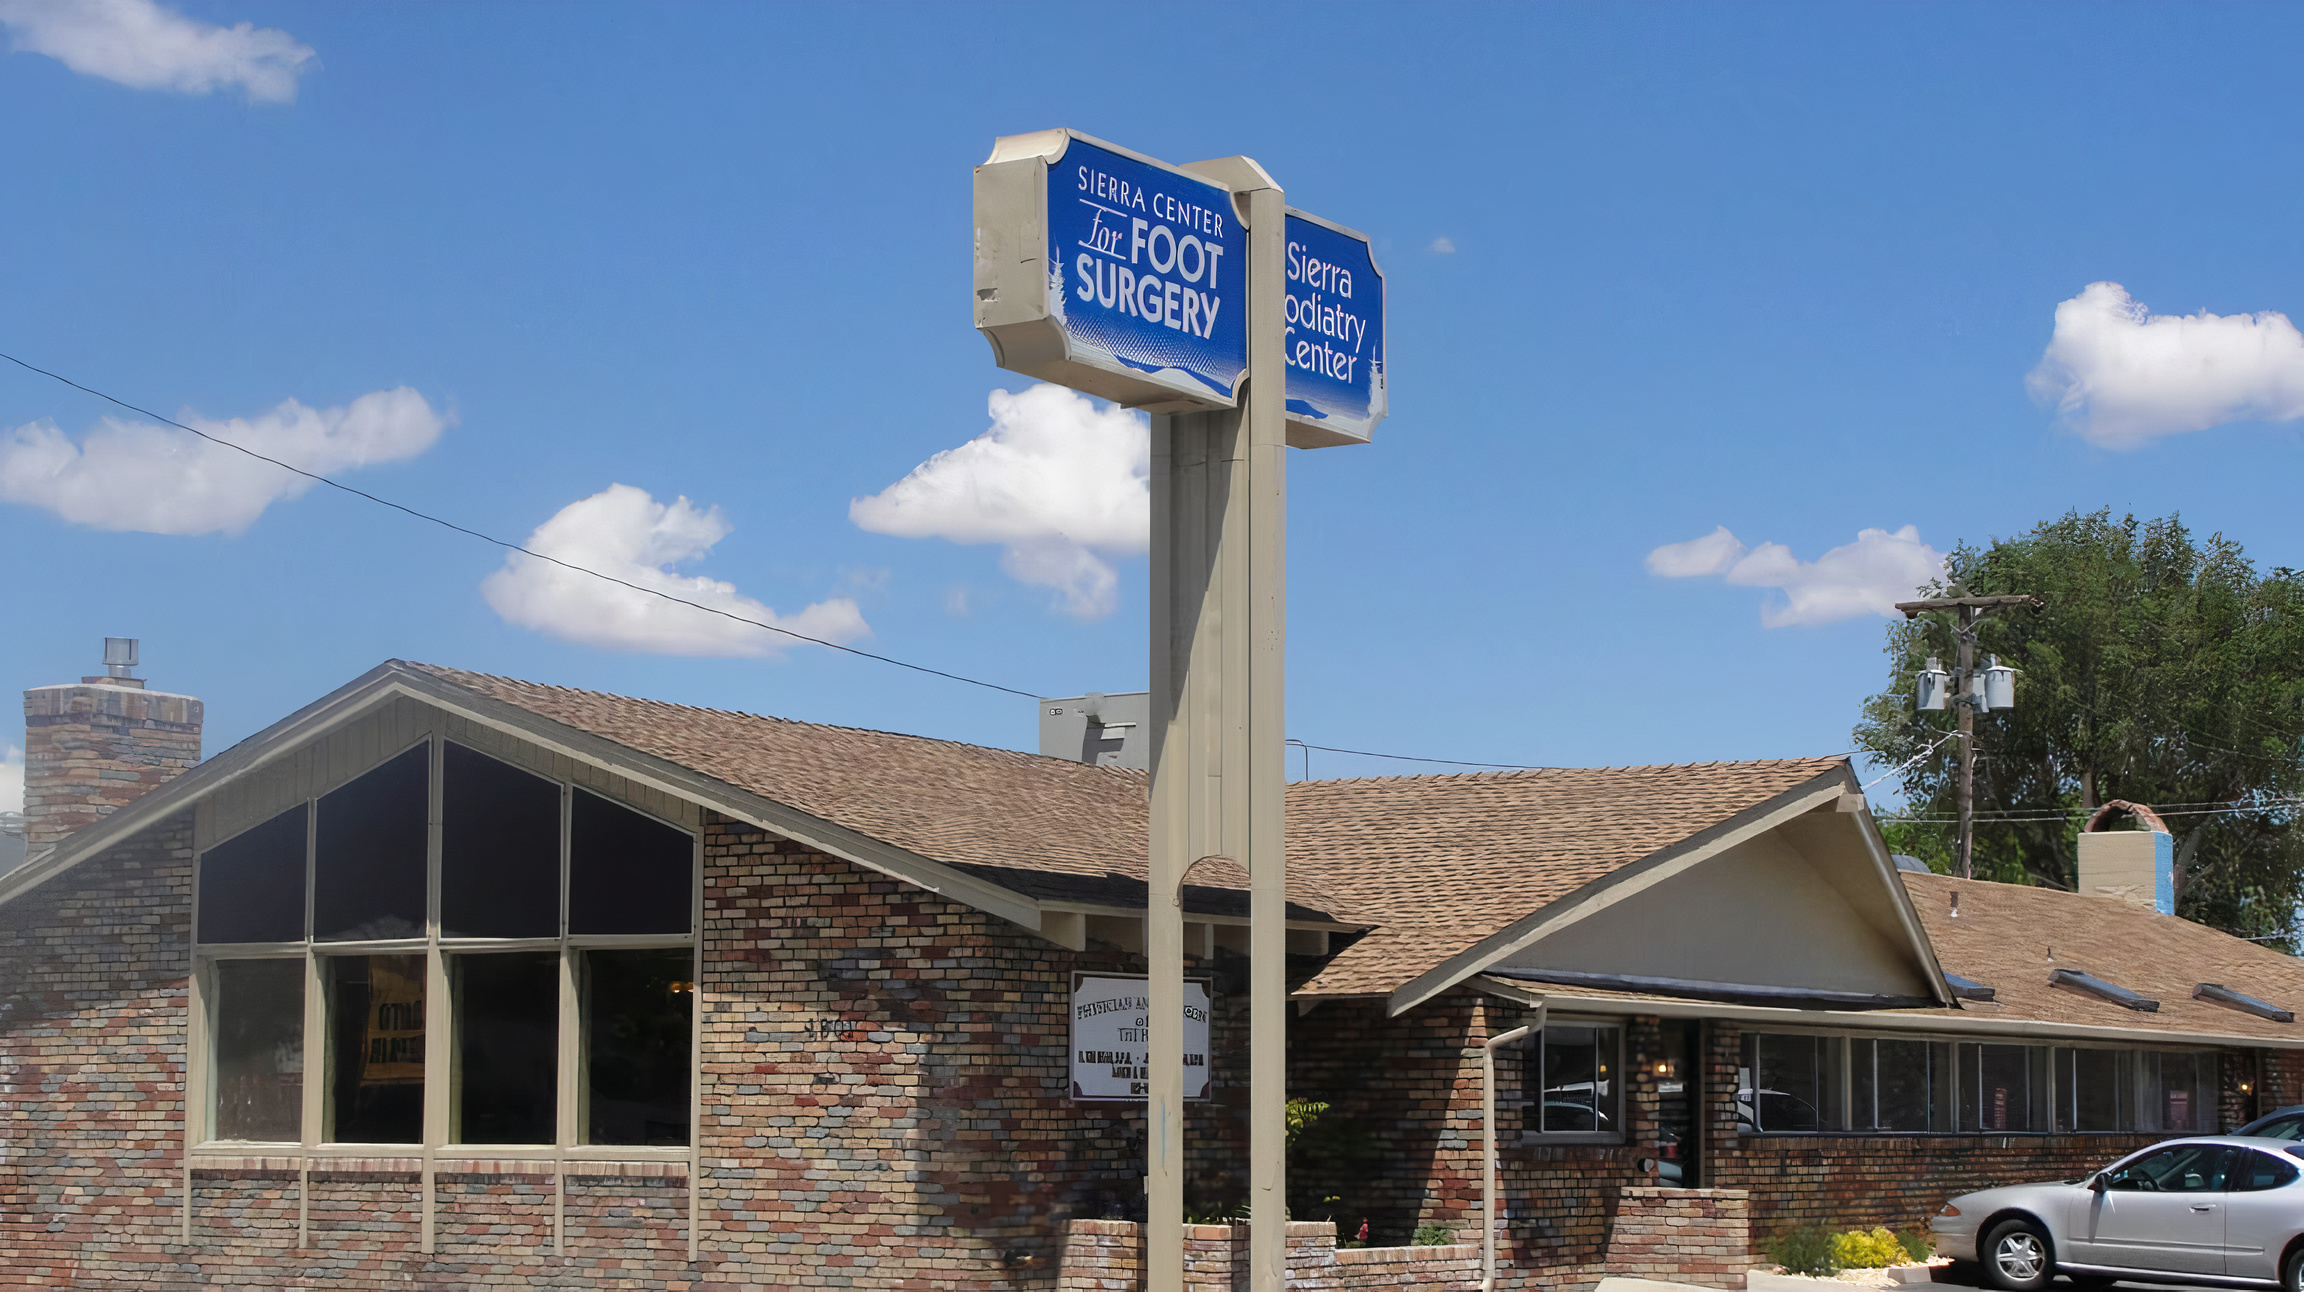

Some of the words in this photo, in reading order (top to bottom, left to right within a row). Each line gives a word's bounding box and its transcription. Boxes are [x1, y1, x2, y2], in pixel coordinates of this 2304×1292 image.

[1078, 166, 1146, 212] SIERRA
[1153, 193, 1223, 238] CENTER
[1087, 208, 1122, 255] for
[1131, 217, 1223, 289] FOOT
[1287, 241, 1352, 299] Sierra
[1076, 253, 1220, 339] SURGERY
[1285, 292, 1366, 353] odiatry
